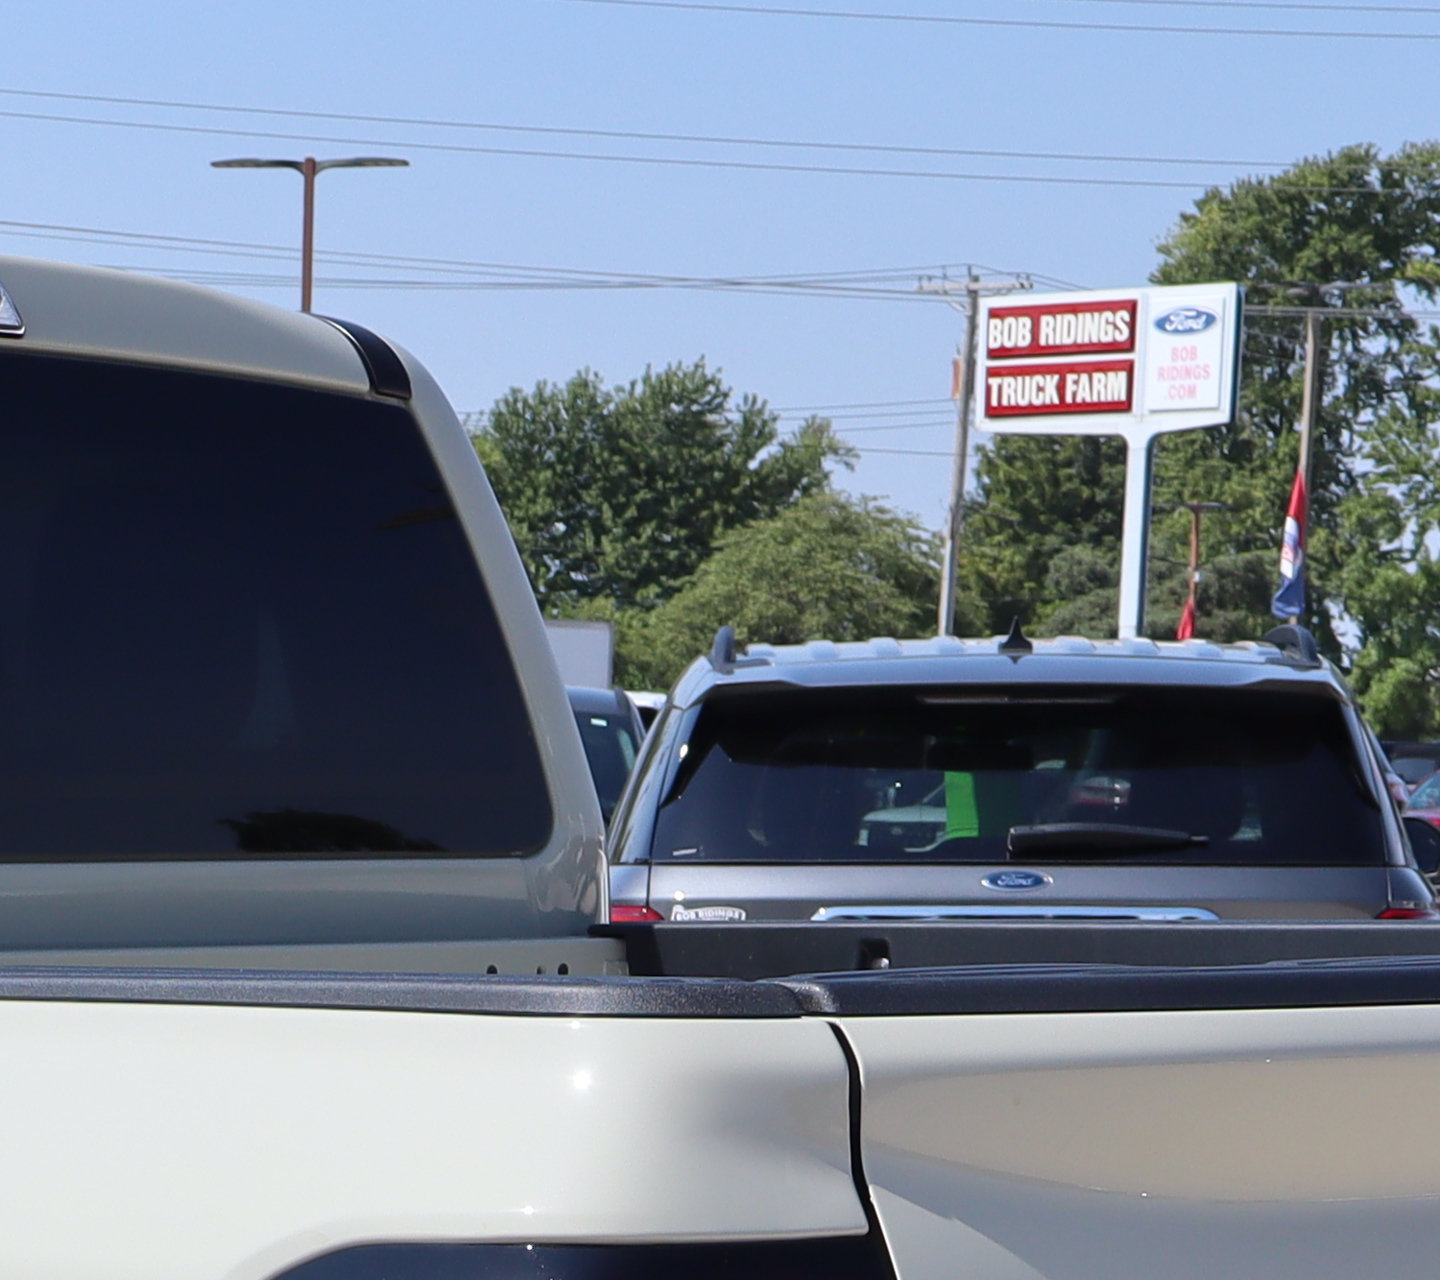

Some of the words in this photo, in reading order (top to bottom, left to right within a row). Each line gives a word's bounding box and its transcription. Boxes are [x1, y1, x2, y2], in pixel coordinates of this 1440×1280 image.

[988, 316, 1032, 350] BOB
[1039, 309, 1131, 347] RIDINGS
[1165, 308, 1207, 332] Ford
[1171, 346, 1198, 362] BOB
[1157, 364, 1211, 381] RIDINGS
[987, 374, 1060, 408] TRUCK
[1065, 371, 1127, 404] FARM
[1164, 384, 1197, 400] .COM
